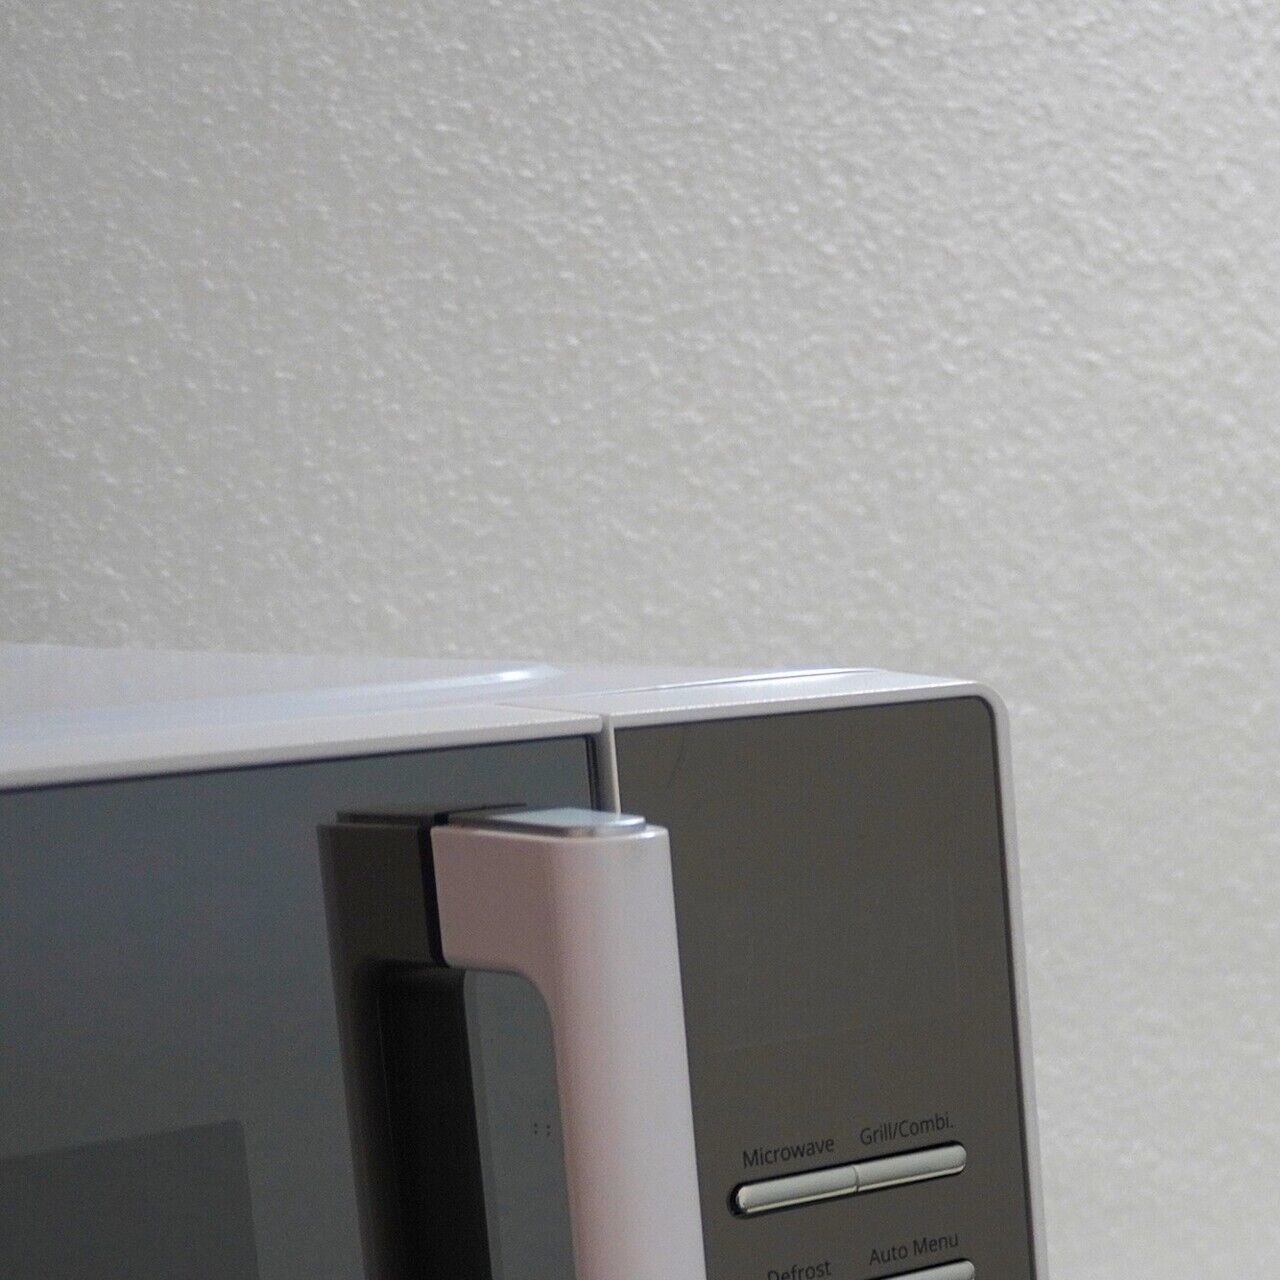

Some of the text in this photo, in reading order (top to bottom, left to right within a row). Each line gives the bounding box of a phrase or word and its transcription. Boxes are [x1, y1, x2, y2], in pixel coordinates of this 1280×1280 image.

[860, 1112, 954, 1146] Grill/Combi.
[743, 1137, 835, 1168] Microwave
[869, 1232, 959, 1265] Auto Menu
